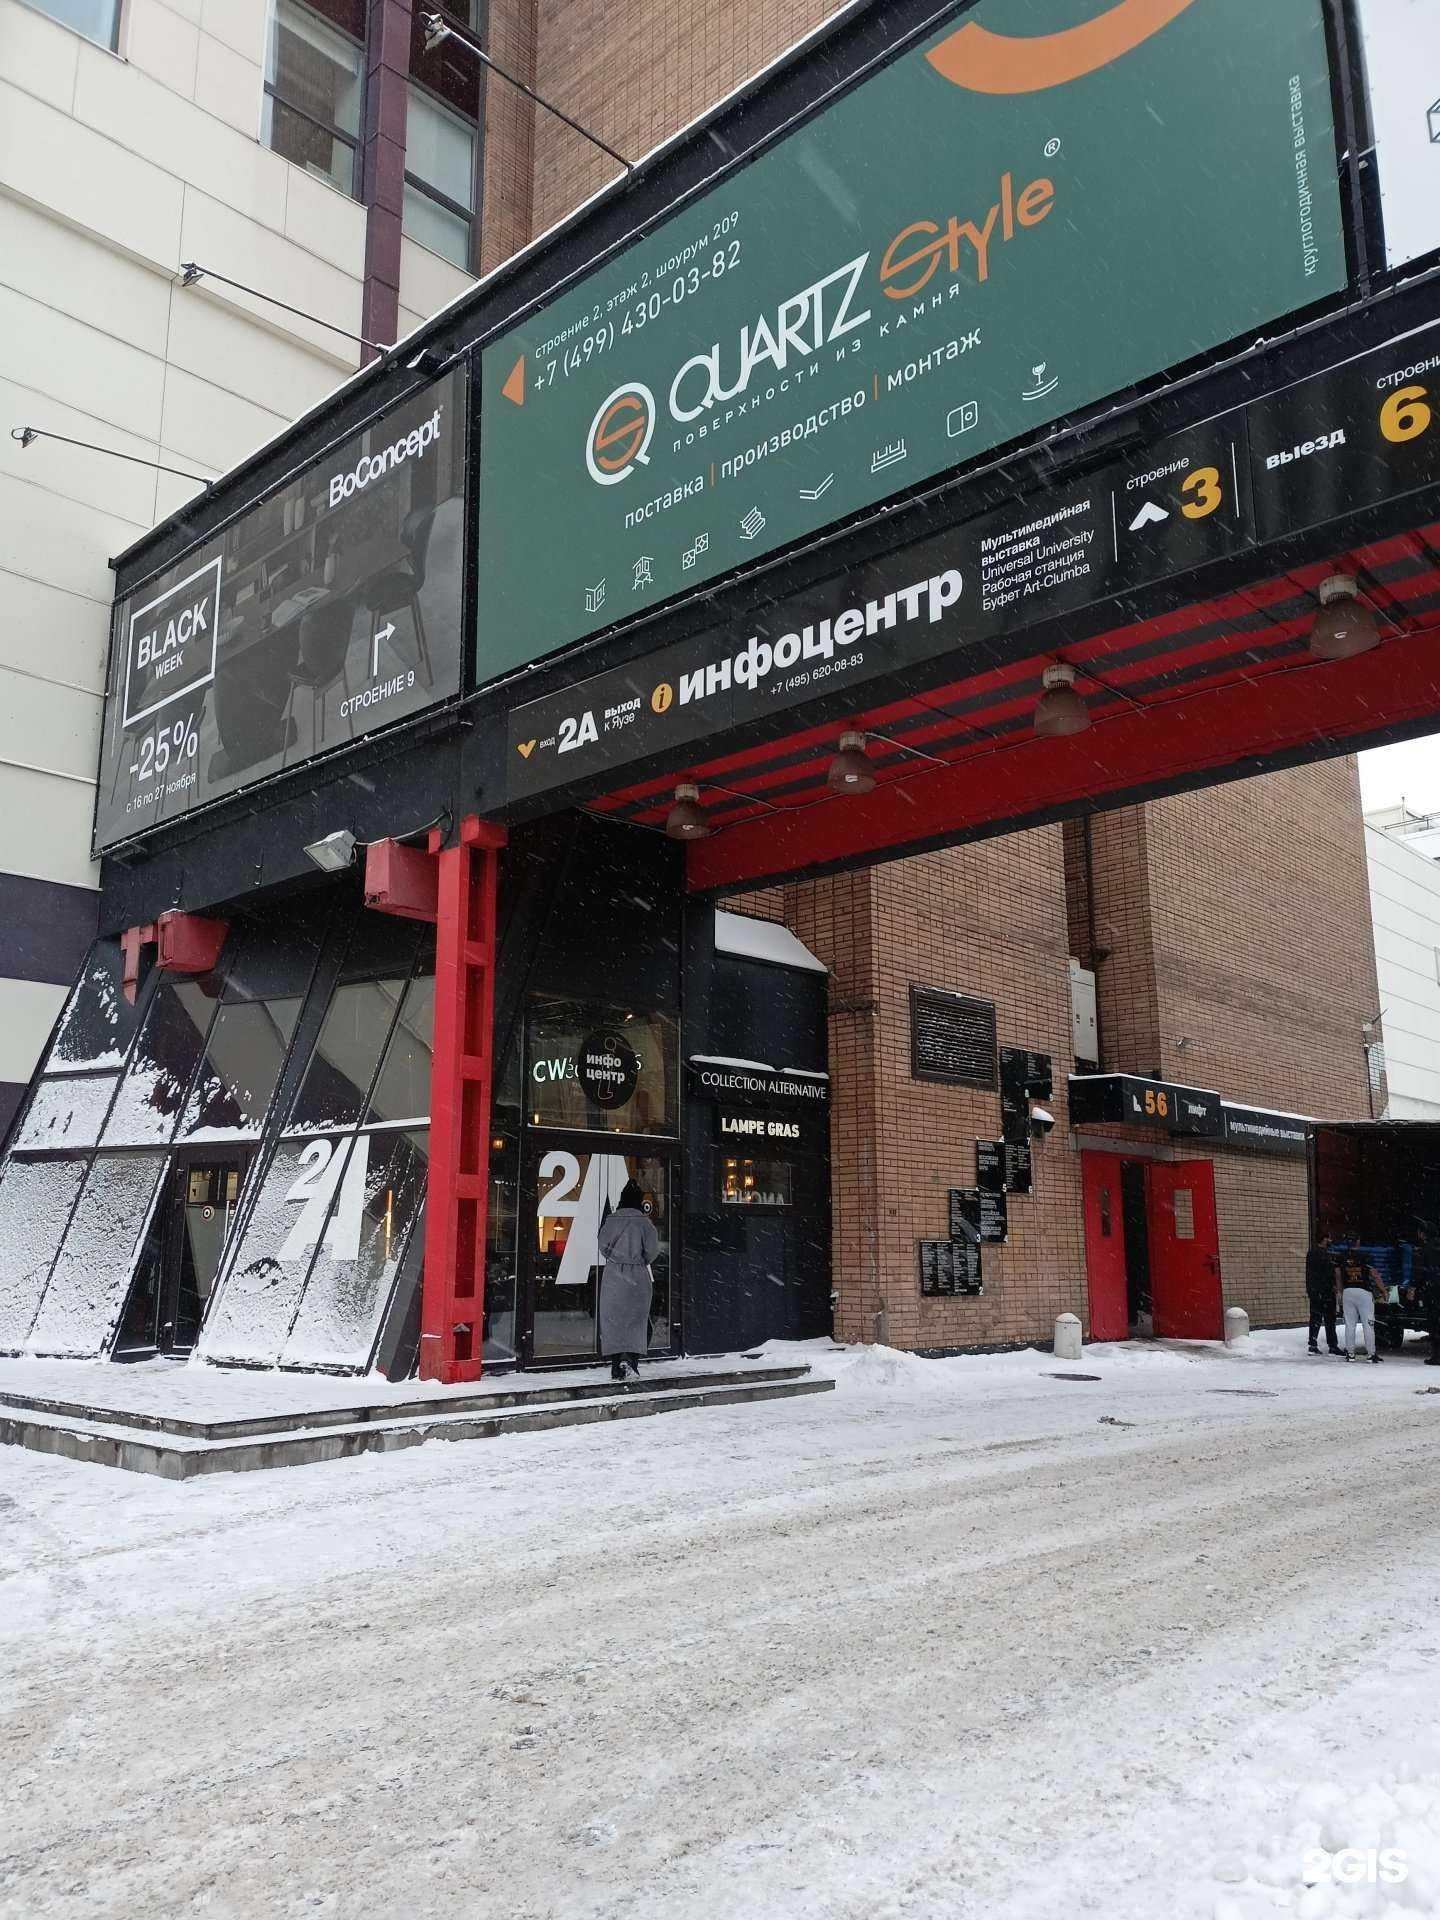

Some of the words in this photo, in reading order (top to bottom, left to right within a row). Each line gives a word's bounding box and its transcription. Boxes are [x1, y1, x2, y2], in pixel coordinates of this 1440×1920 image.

[1288, 74, 1306, 148] выставка
[1296, 148, 1319, 277] круглогодичная
[535, 312, 589, 359] строение
[606, 283, 638, 313] этаж
[656, 233, 709, 279] шоурум
[712, 210, 739, 241] 209
[669, 251, 871, 423] QUARTZ
[880, 170, 1055, 299] Style
[534, 358, 558, 391] +7
[563, 322, 614, 377] (499)
[621, 240, 741, 335] 430-03-82
[625, 475, 704, 528] поставка
[721, 390, 866, 478] производство
[887, 327, 982, 391] монтаж
[1380, 385, 1431, 442] 6
[329, 409, 441, 508] BoConcept
[1266, 428, 1346, 470] выезд
[1126, 457, 1190, 491] строение
[1181, 466, 1222, 519] 3
[980, 499, 1091, 552] Мультимедийная
[981, 536, 1041, 567] выставка
[982, 551, 1034, 582] Universal
[1036, 529, 1094, 560] University
[983, 569, 1032, 596] Рабочая
[1035, 549, 1085, 576] станция
[983, 588, 1021, 611] Буфет
[1023, 562, 1091, 596] Art-Clumba
[137, 597, 208, 670] BLACK
[679, 569, 963, 705] инфоцентр
[155, 651, 184, 680] WEEK
[770, 682, 782, 695] +7
[785, 672, 809, 692] (495)
[812, 653, 864, 680] 620-08-83
[340, 676, 404, 719] СТРОЕНИЕ
[406, 670, 415, 688] 9
[604, 697, 641, 719] выход
[539, 736, 556, 749] вход
[604, 721, 610, 732] к
[612, 712, 635, 732] Яузе
[129, 713, 198, 782] -25%
[126, 801, 132, 813] с
[133, 794, 142, 810] 16
[144, 792, 154, 804] по
[155, 781, 164, 800] 27
[166, 772, 196, 795] ноября
[586, 1053, 622, 1069] инфо
[586, 1068, 626, 1085] центр
[701, 1071, 766, 1092] COLLECTION
[768, 1081, 827, 1099] ALTERNATIVE
[721, 1117, 765, 1135] LAMPE
[767, 1121, 800, 1138] GRAS
